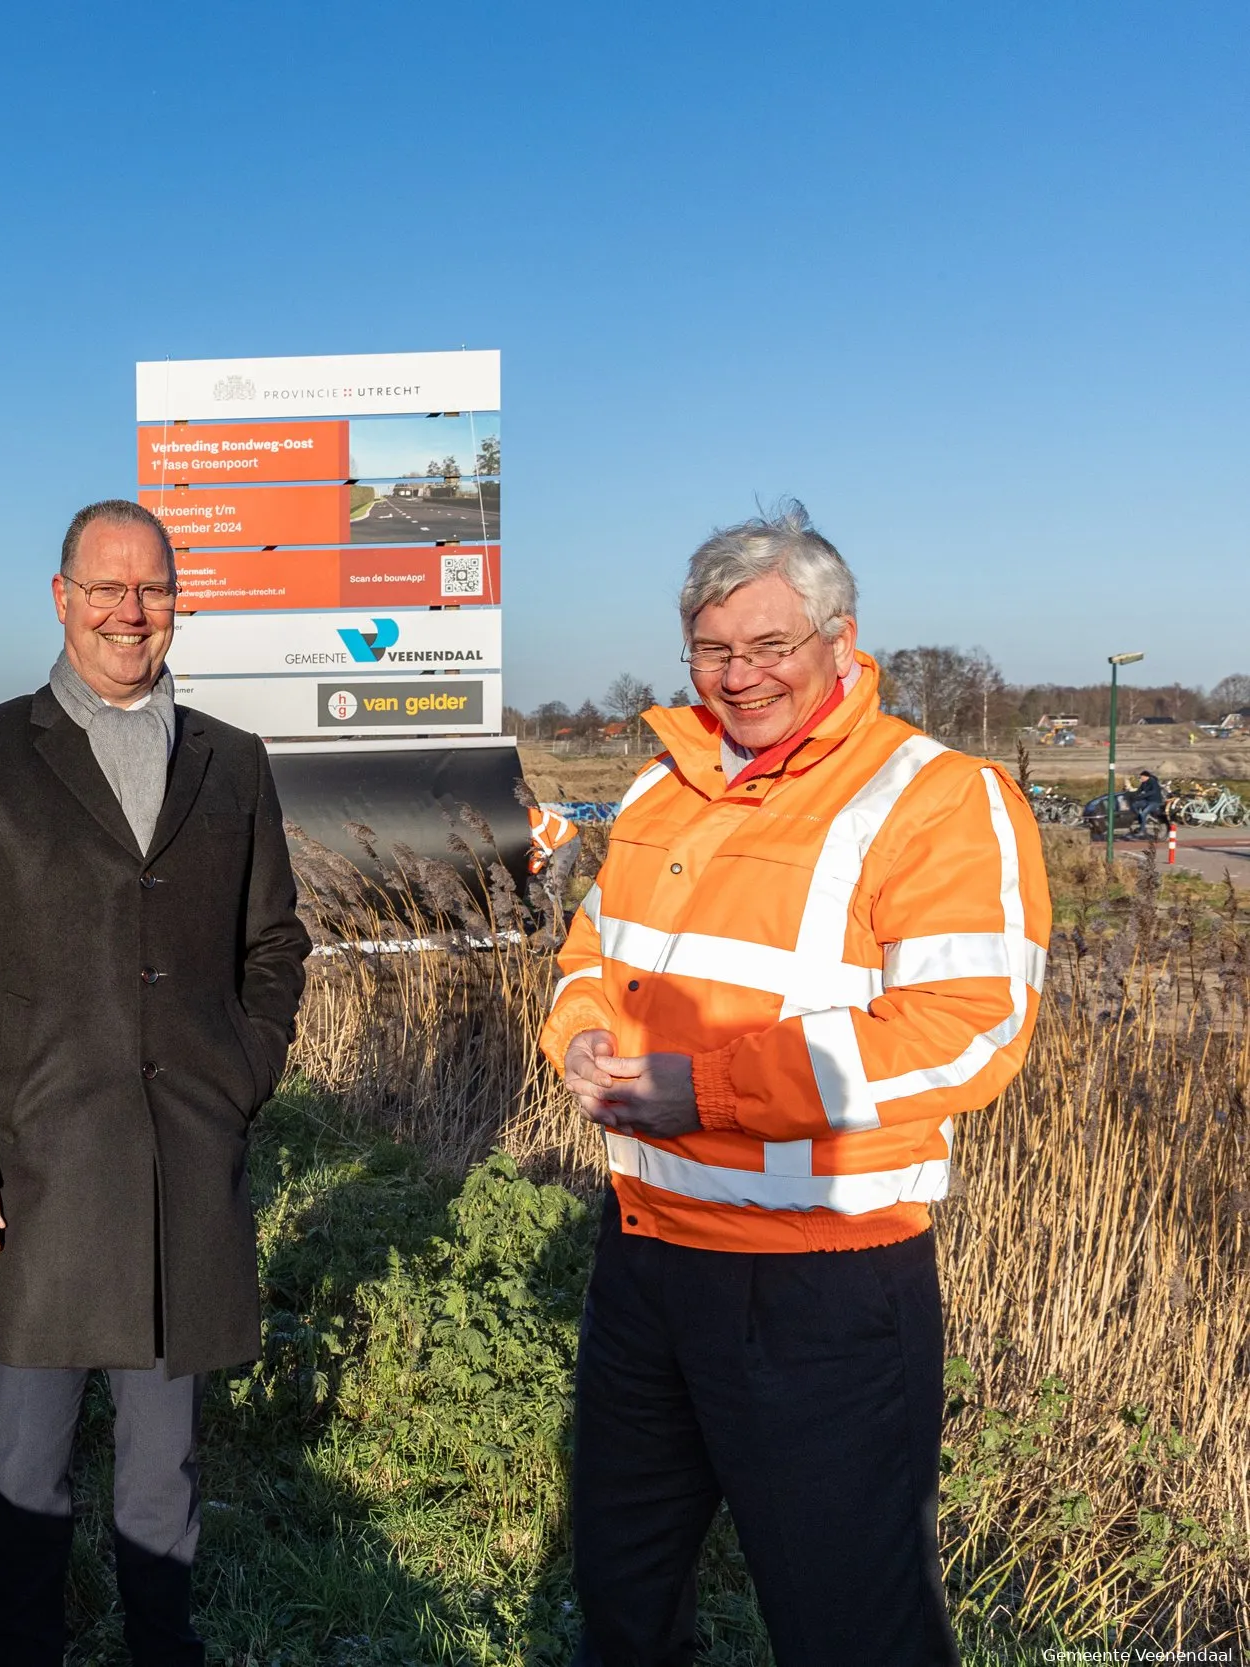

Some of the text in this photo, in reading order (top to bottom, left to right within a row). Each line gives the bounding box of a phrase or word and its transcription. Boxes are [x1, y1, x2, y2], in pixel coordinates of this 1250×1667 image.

[263, 386, 421, 400] PROVINCIE UTRECHT
[151, 438, 314, 454] Verbreding Rondweg-Oost
[163, 458, 189, 471] fase
[191, 457, 259, 472] Groenpoort
[152, 504, 236, 518] Uitvoering t/m
[165, 522, 242, 534] cember 2024
[176, 567, 216, 576] nformatie:
[350, 573, 426, 583] Scan de bouwApp!
[285, 650, 483, 665] GEMEENTE VEENENDAAL
[363, 693, 468, 716] van gelder
